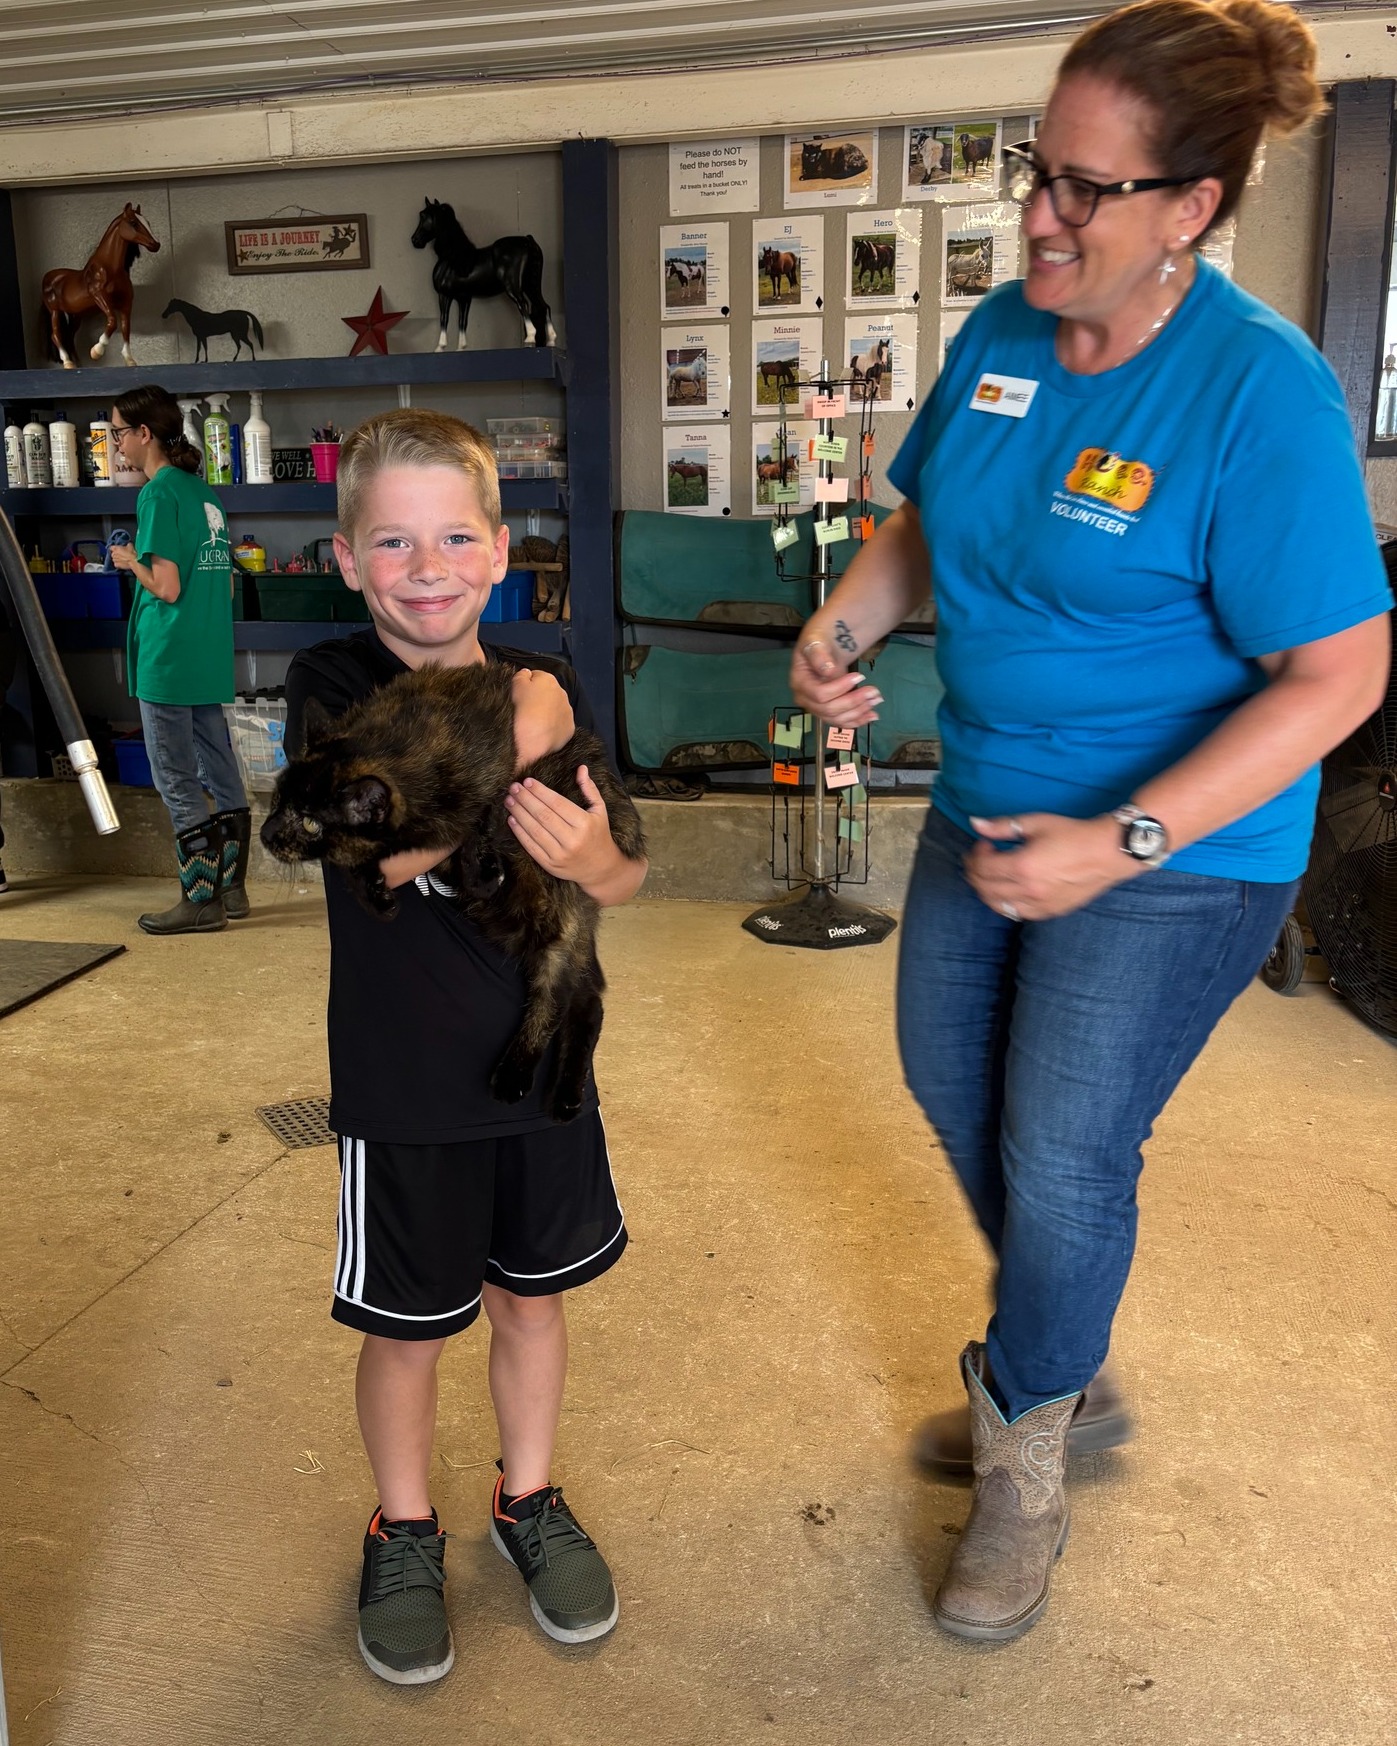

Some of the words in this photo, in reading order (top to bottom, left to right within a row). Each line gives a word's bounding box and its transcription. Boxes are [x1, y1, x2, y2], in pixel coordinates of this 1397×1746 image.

[685, 150, 711, 159] Please
[712, 148, 722, 157] do
[723, 146, 742, 156] NOT
[679, 162, 696, 170] feed
[697, 160, 710, 169] the
[711, 159, 737, 168] horses
[738, 158, 748, 167] by
[702, 170, 724, 179] hand!
[730, 179, 748, 187] ONLY!
[873, 219, 894, 228] Hero
[783, 225, 793, 235] EJ
[238, 233, 259, 247] LIFE
[260, 232, 269, 246] IS
[271, 231, 278, 245] A
[279, 230, 321, 245] JOURNEY
[680, 232, 708, 241] Banner
[246, 250, 272, 261] Enjoy
[274, 248, 292, 257] The
[773, 326, 801, 335] Minnie
[867, 324, 894, 332] Peanut
[685, 334, 705, 343] Lynx
[685, 434, 707, 442] Tanna
[281, 450, 302, 461] WELL
[1049, 500, 1129, 537] VOLUNTEER
